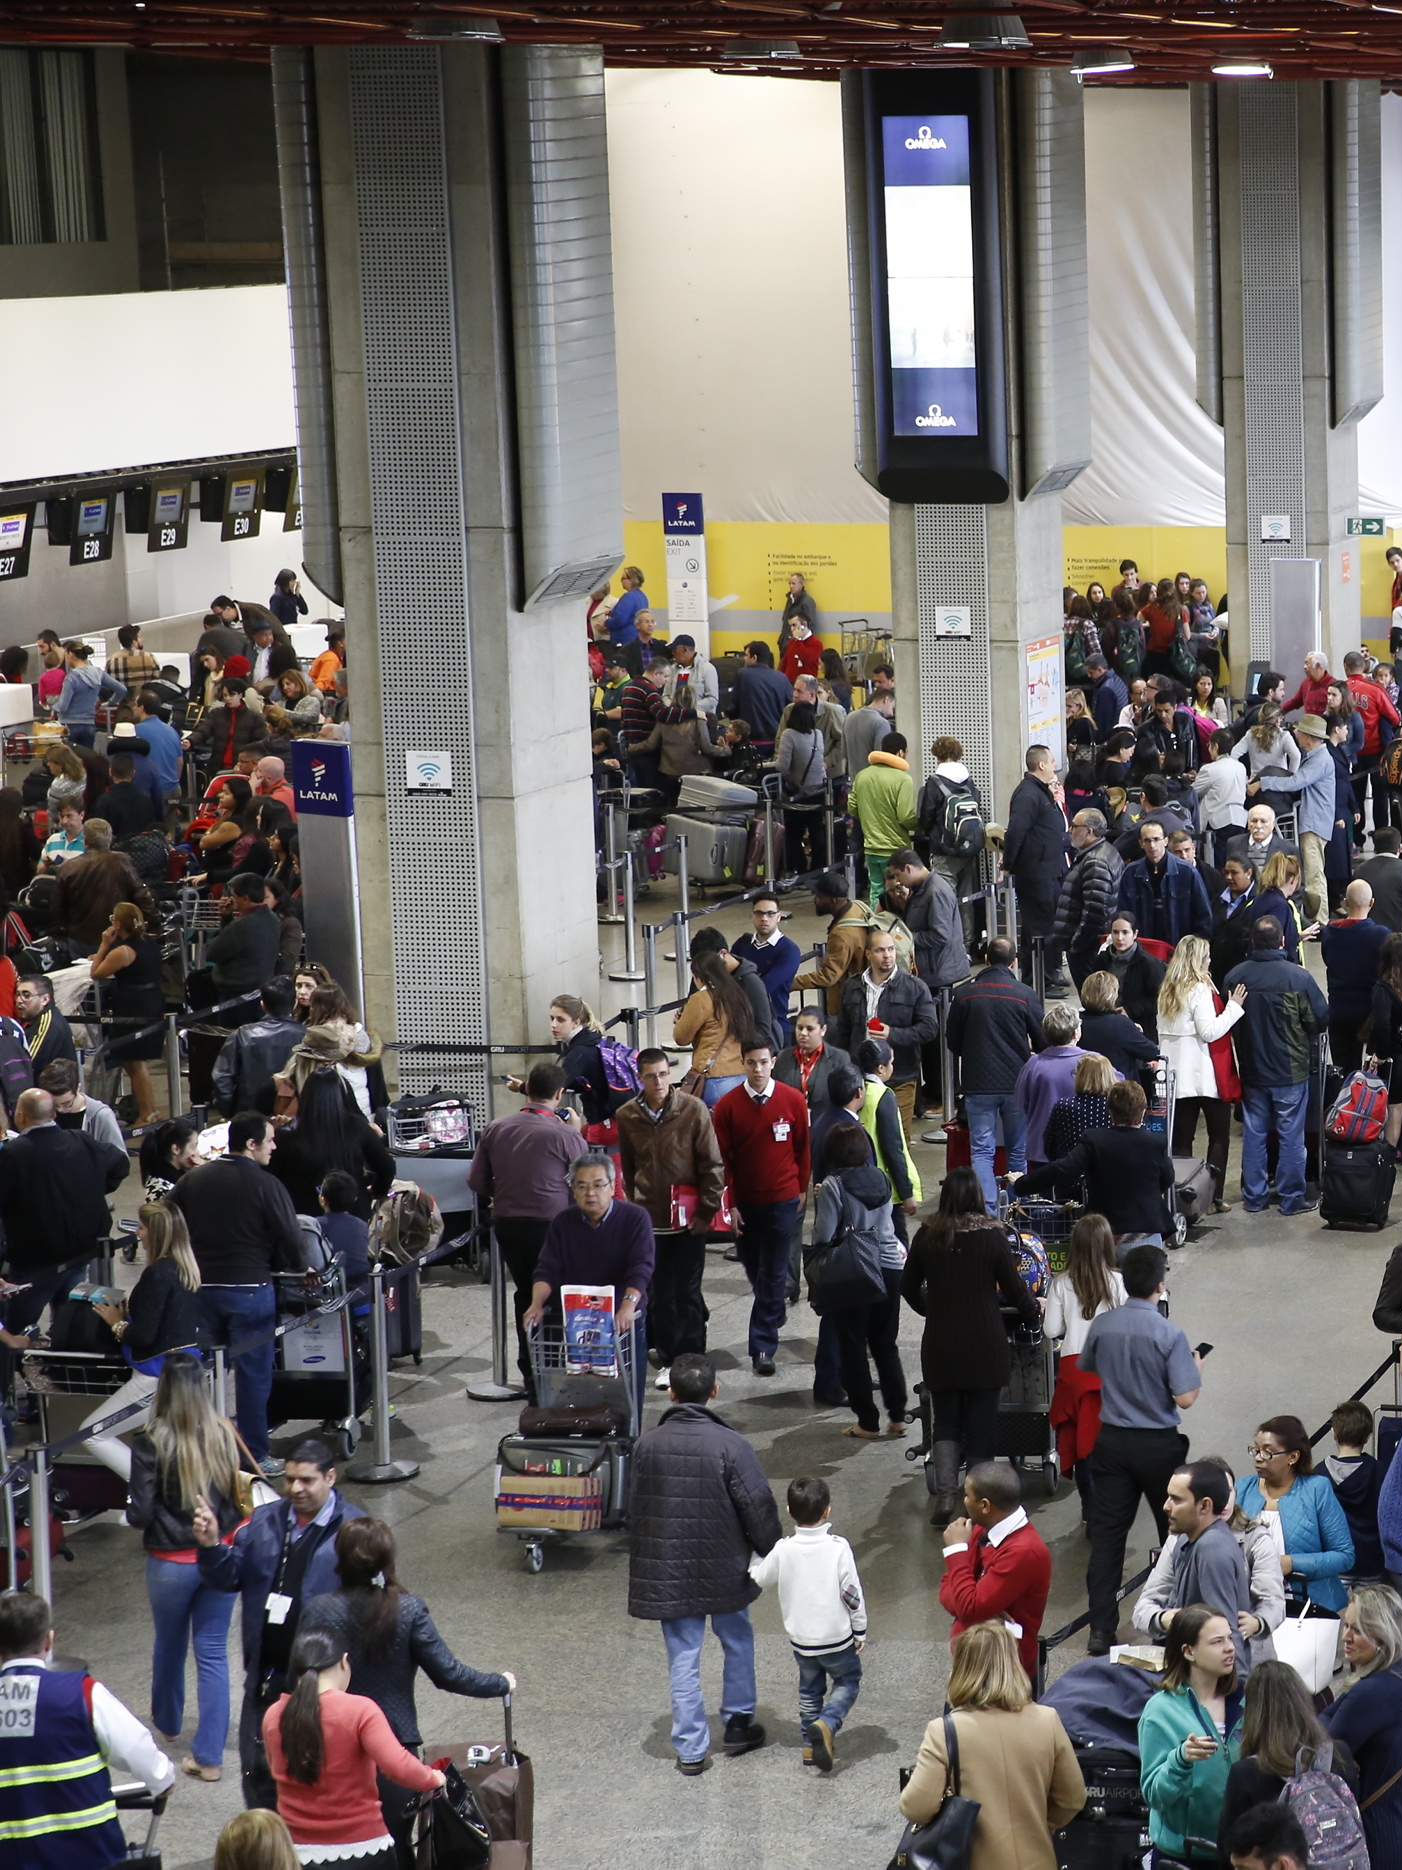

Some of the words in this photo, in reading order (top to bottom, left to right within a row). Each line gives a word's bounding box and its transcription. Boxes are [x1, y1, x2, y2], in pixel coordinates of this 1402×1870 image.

[905, 138, 946, 150] OMEGA
[915, 416, 957, 428] OMEGA
[234, 517, 250, 535] E30
[161, 528, 176, 546] E29
[666, 538, 691, 547] SAÍDA
[83, 540, 100, 558] E28
[666, 548, 681, 556] EXIT
[300, 789, 338, 802] LATAM
[0, 1708, 32, 1728] 03
